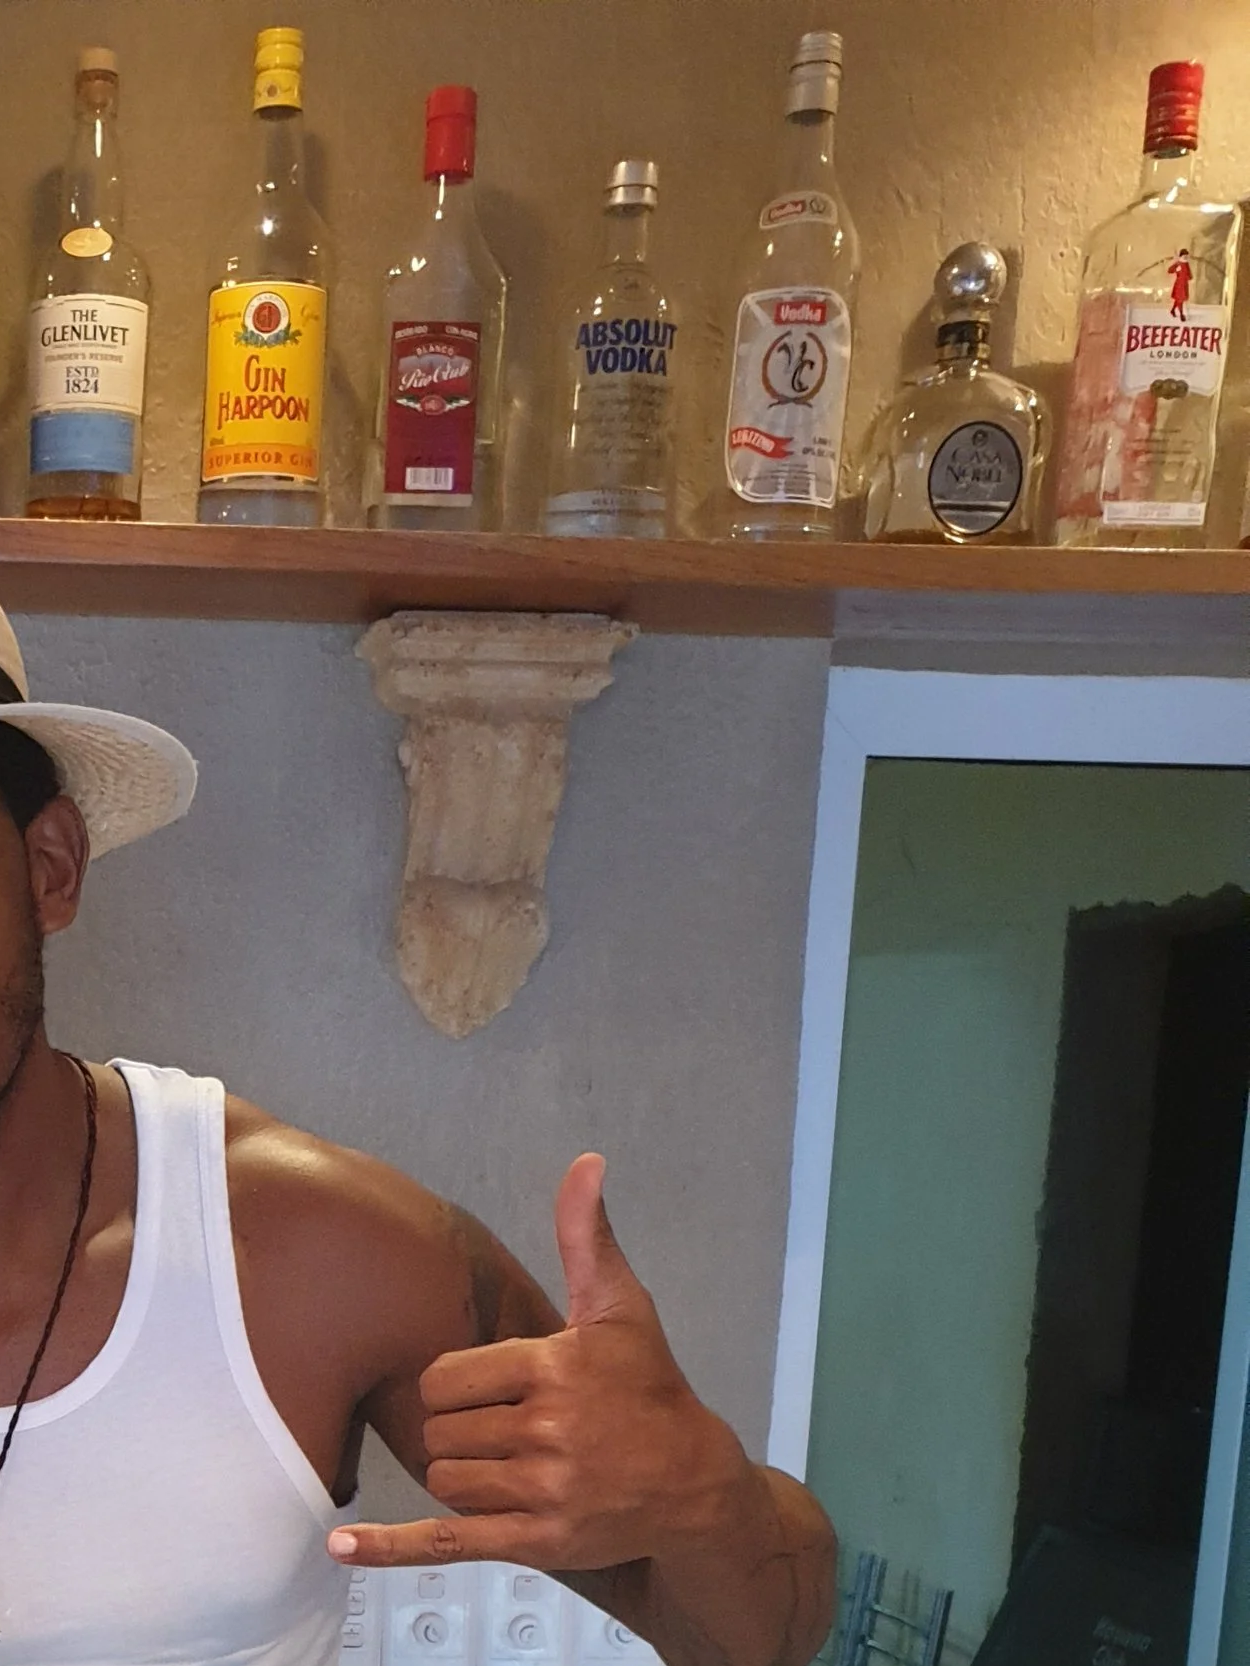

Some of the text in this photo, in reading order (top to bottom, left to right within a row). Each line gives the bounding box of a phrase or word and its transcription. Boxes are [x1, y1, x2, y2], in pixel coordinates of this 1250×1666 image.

[71, 309, 98, 323] THE
[780, 303, 823, 322] Vodka
[41, 324, 130, 348] GLENLIVET
[575, 318, 678, 350] ABSOLUT
[1125, 325, 1223, 355] BEEFEATER
[415, 343, 455, 356] BLANCO
[1149, 350, 1198, 359] LONDON
[586, 347, 668, 376] VODKA
[244, 354, 286, 393] GIN
[65, 378, 99, 394] 1824
[217, 391, 310, 430] HARPOON
[207, 451, 313, 470] SUPERIOR GIN
